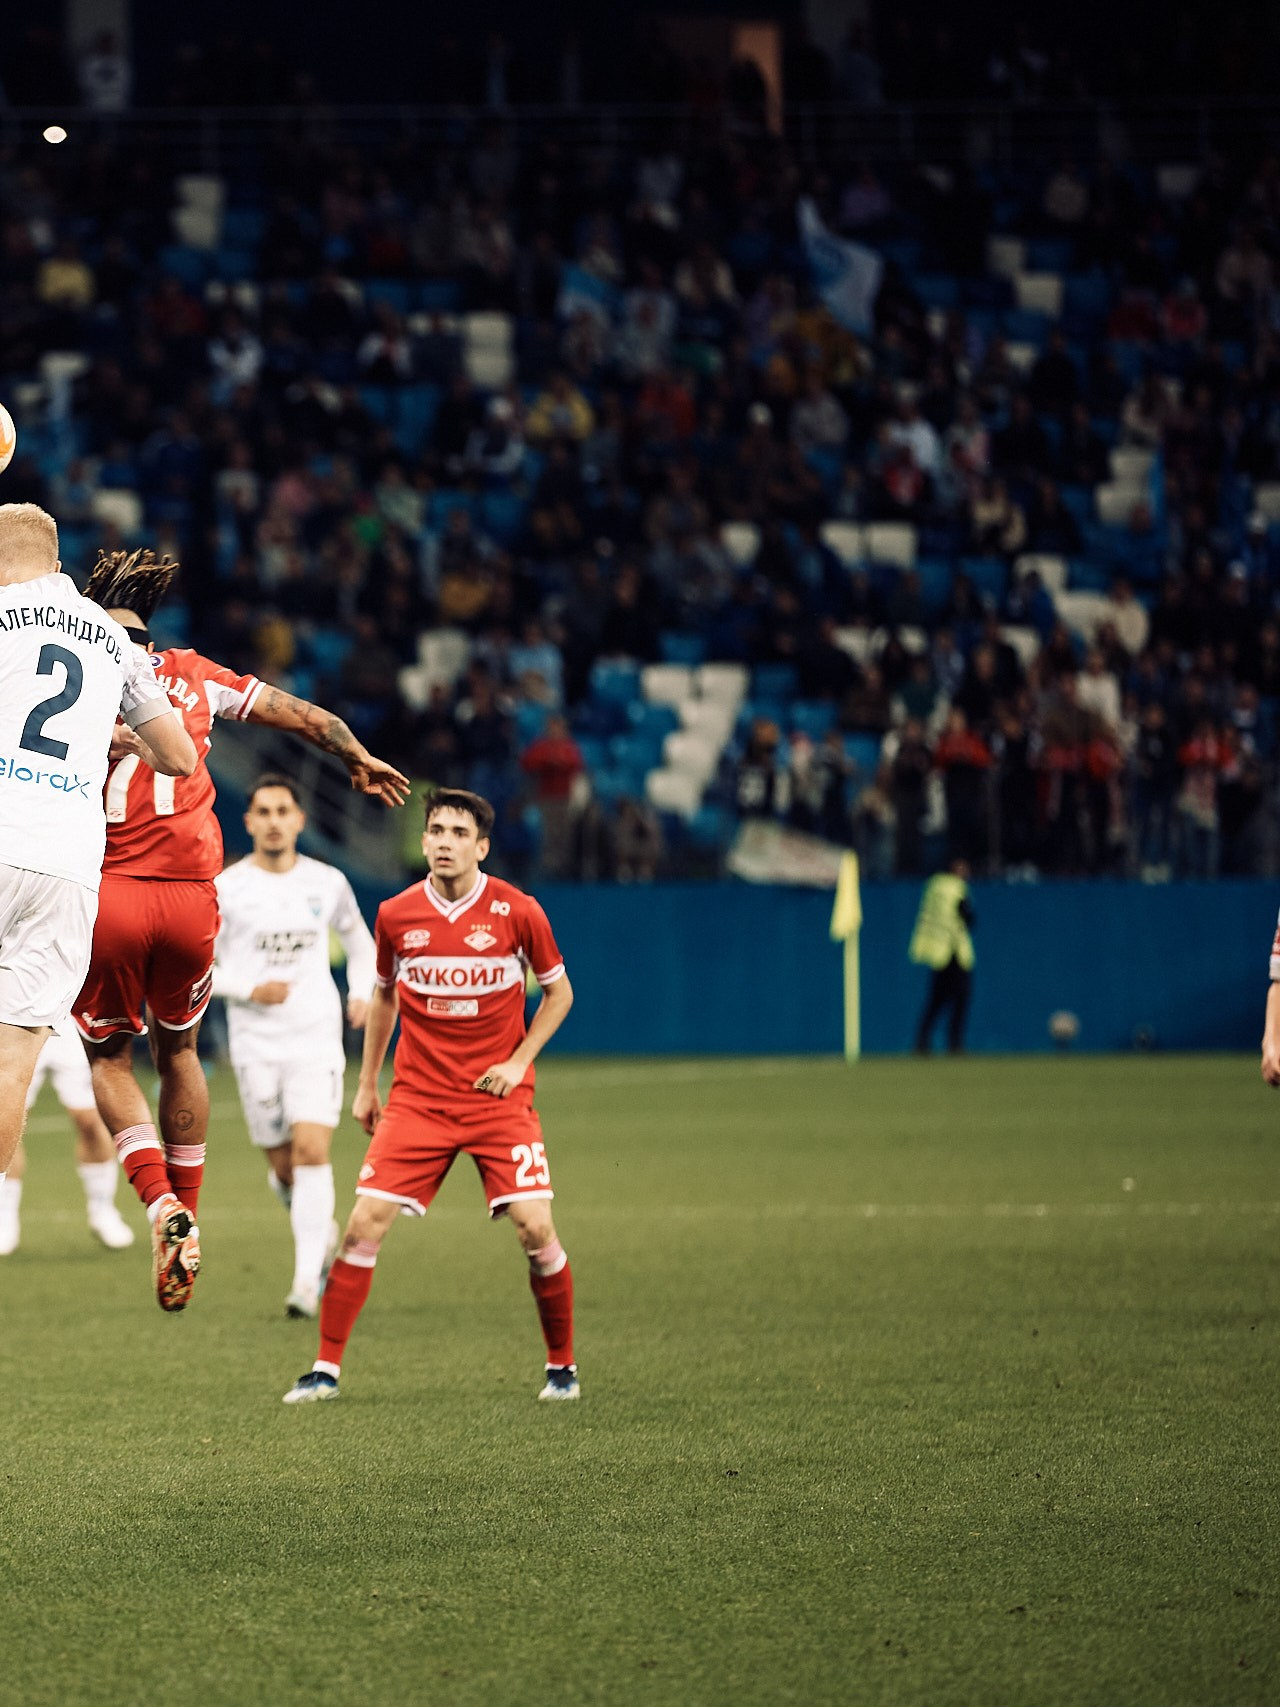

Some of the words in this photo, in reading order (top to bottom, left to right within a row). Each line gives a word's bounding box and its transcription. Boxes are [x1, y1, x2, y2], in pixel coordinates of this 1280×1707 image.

[19, 643, 83, 761] 2
[408, 963, 505, 987] ЛУКОЙЛ
[511, 1141, 551, 1188] 25
